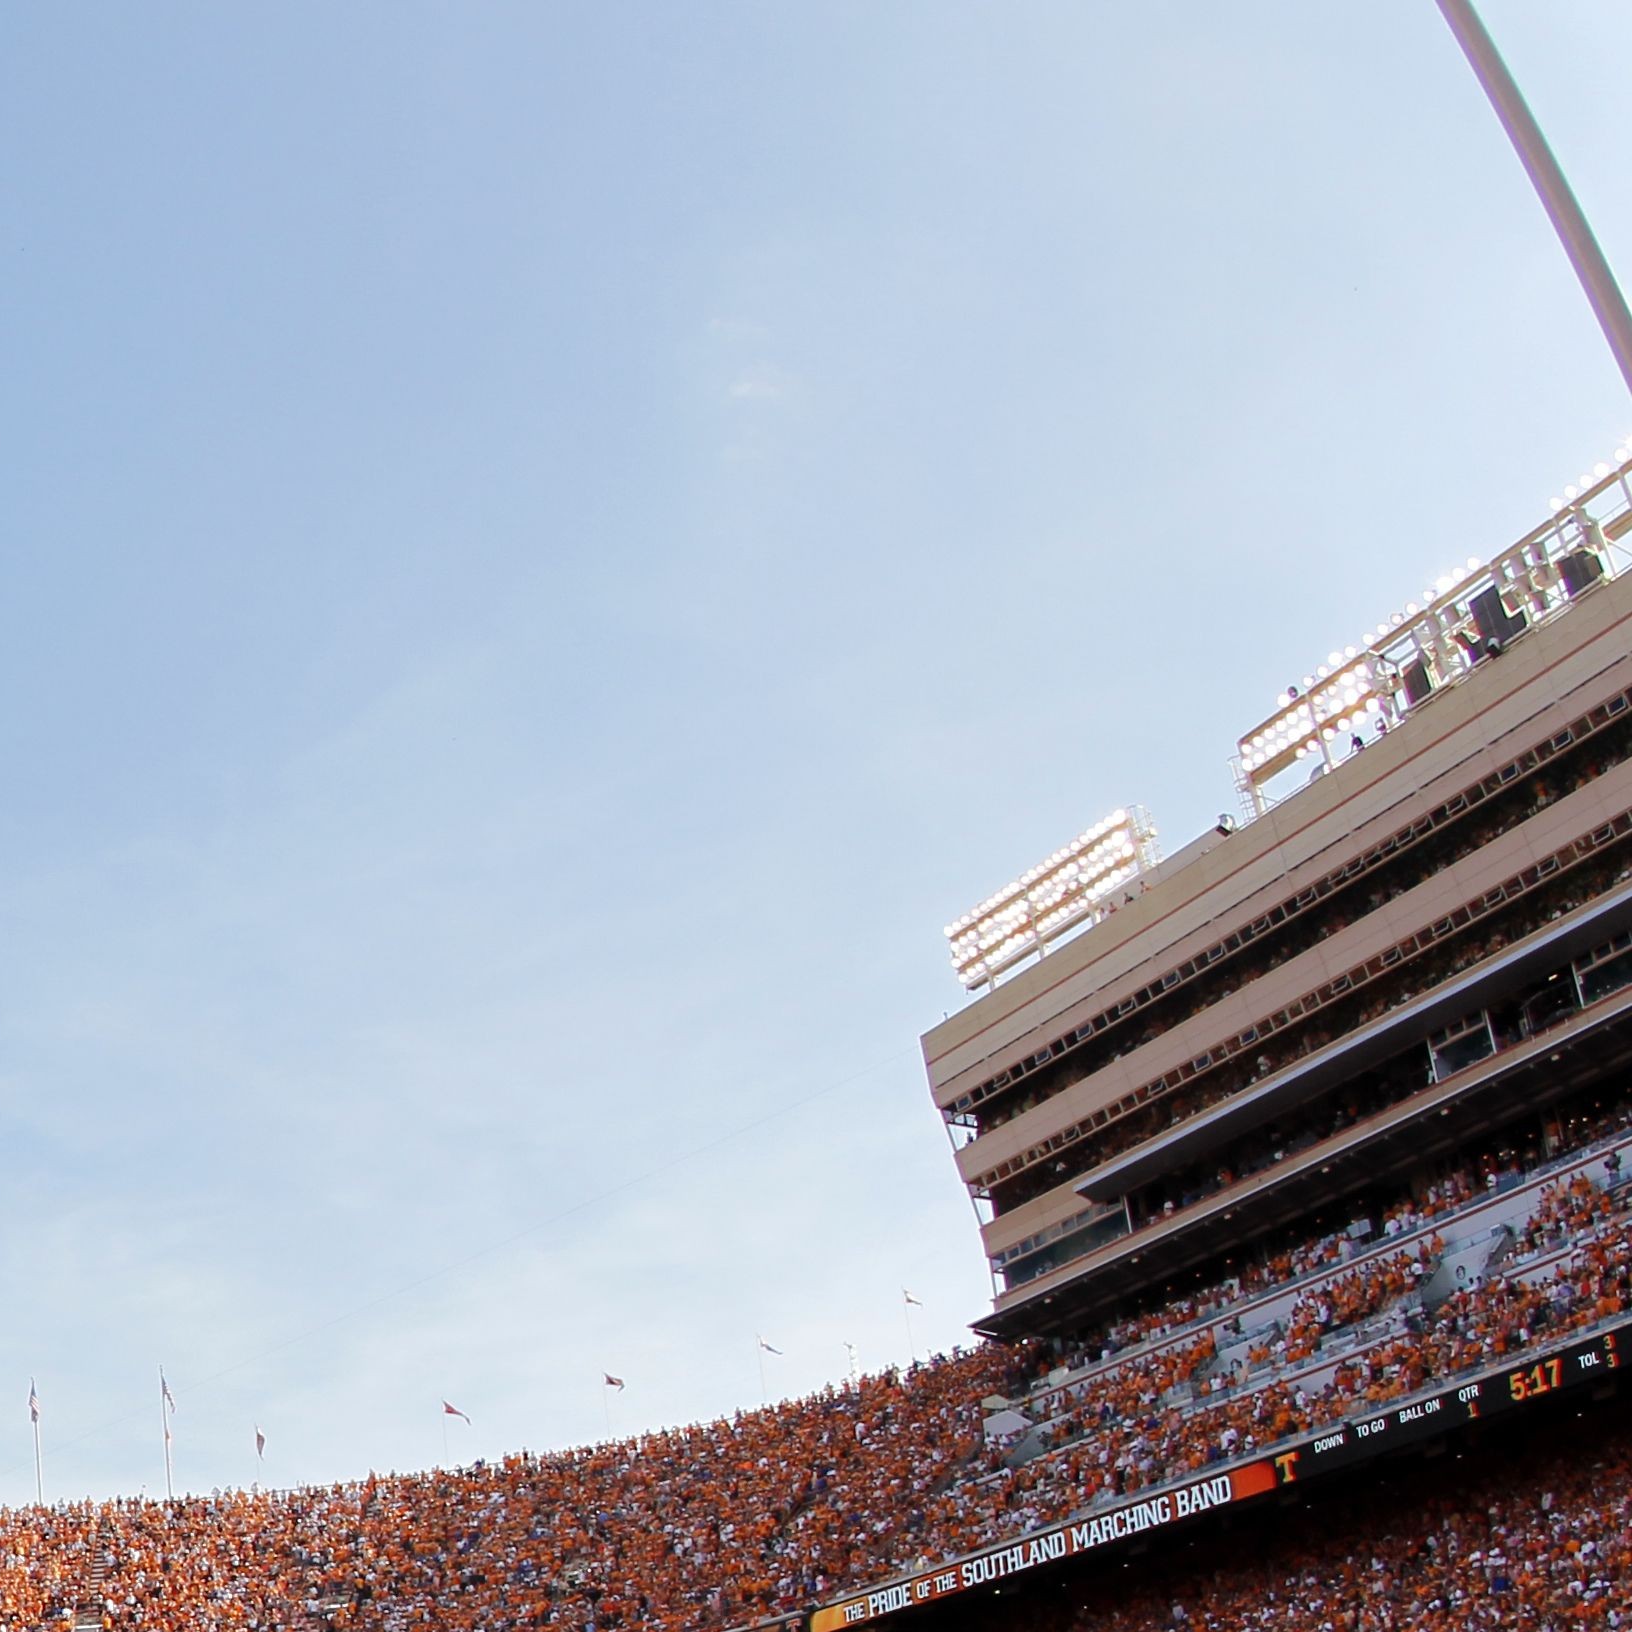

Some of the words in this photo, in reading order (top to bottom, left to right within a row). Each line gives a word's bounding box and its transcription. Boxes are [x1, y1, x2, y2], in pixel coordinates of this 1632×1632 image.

[1603, 1333, 1616, 1349] 3
[1578, 1352, 1600, 1369] TOL
[1606, 1353, 1620, 1369] 3
[1509, 1357, 1563, 1400] 5:17
[1458, 1384, 1479, 1402] QTR
[1399, 1406, 1424, 1424] BALL
[1425, 1398, 1440, 1414] ON
[1467, 1402, 1480, 1418] 1
[1356, 1424, 1370, 1438] TO
[1370, 1418, 1386, 1433] GO
[1314, 1433, 1344, 1453] DOWN
[1275, 1451, 1301, 1483] T
[843, 1602, 865, 1622] THE
[867, 1582, 913, 1618] PRIDE
[916, 1579, 933, 1599] OF
[934, 1571, 957, 1593] THE
[961, 1532, 1066, 1587] SOUTHLAND
[1070, 1496, 1170, 1552] MARCHING
[1174, 1475, 1232, 1518] BAND
